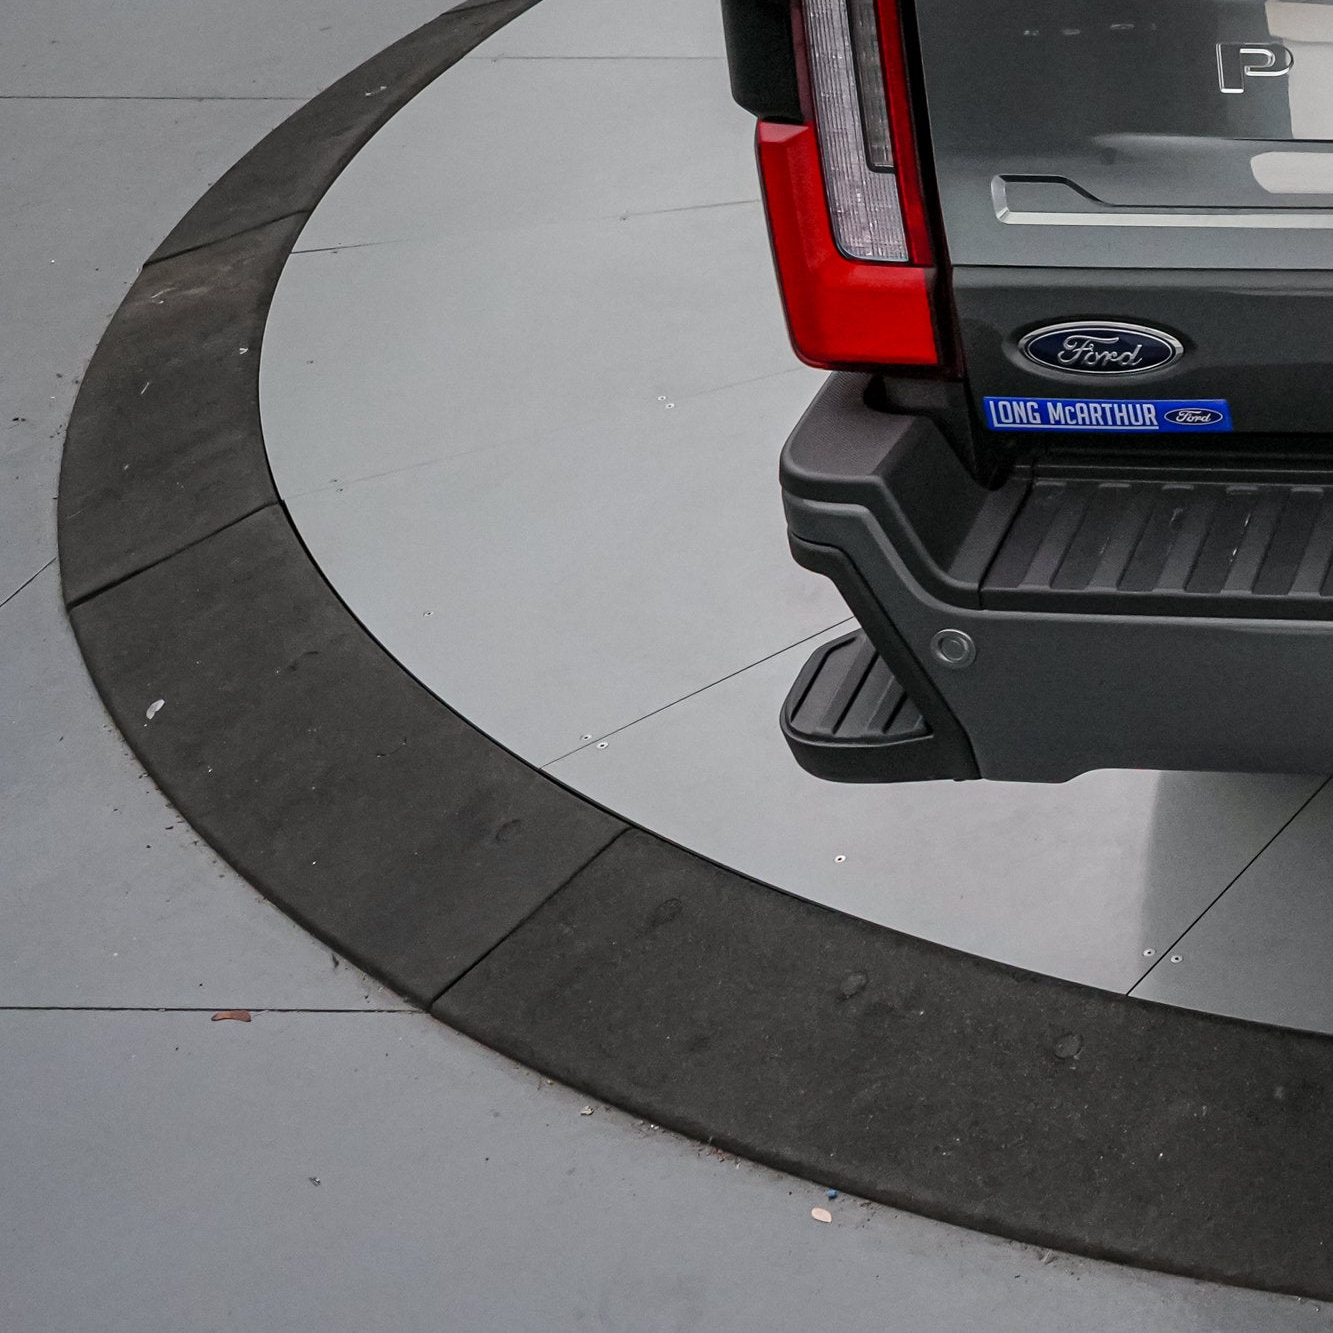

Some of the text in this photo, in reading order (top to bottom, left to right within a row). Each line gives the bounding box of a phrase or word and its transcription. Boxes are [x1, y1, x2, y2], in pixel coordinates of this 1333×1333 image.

[1057, 334, 1144, 366] Ford
[989, 400, 1159, 426] LONG McARTHUR
[1175, 409, 1212, 423] Ford
